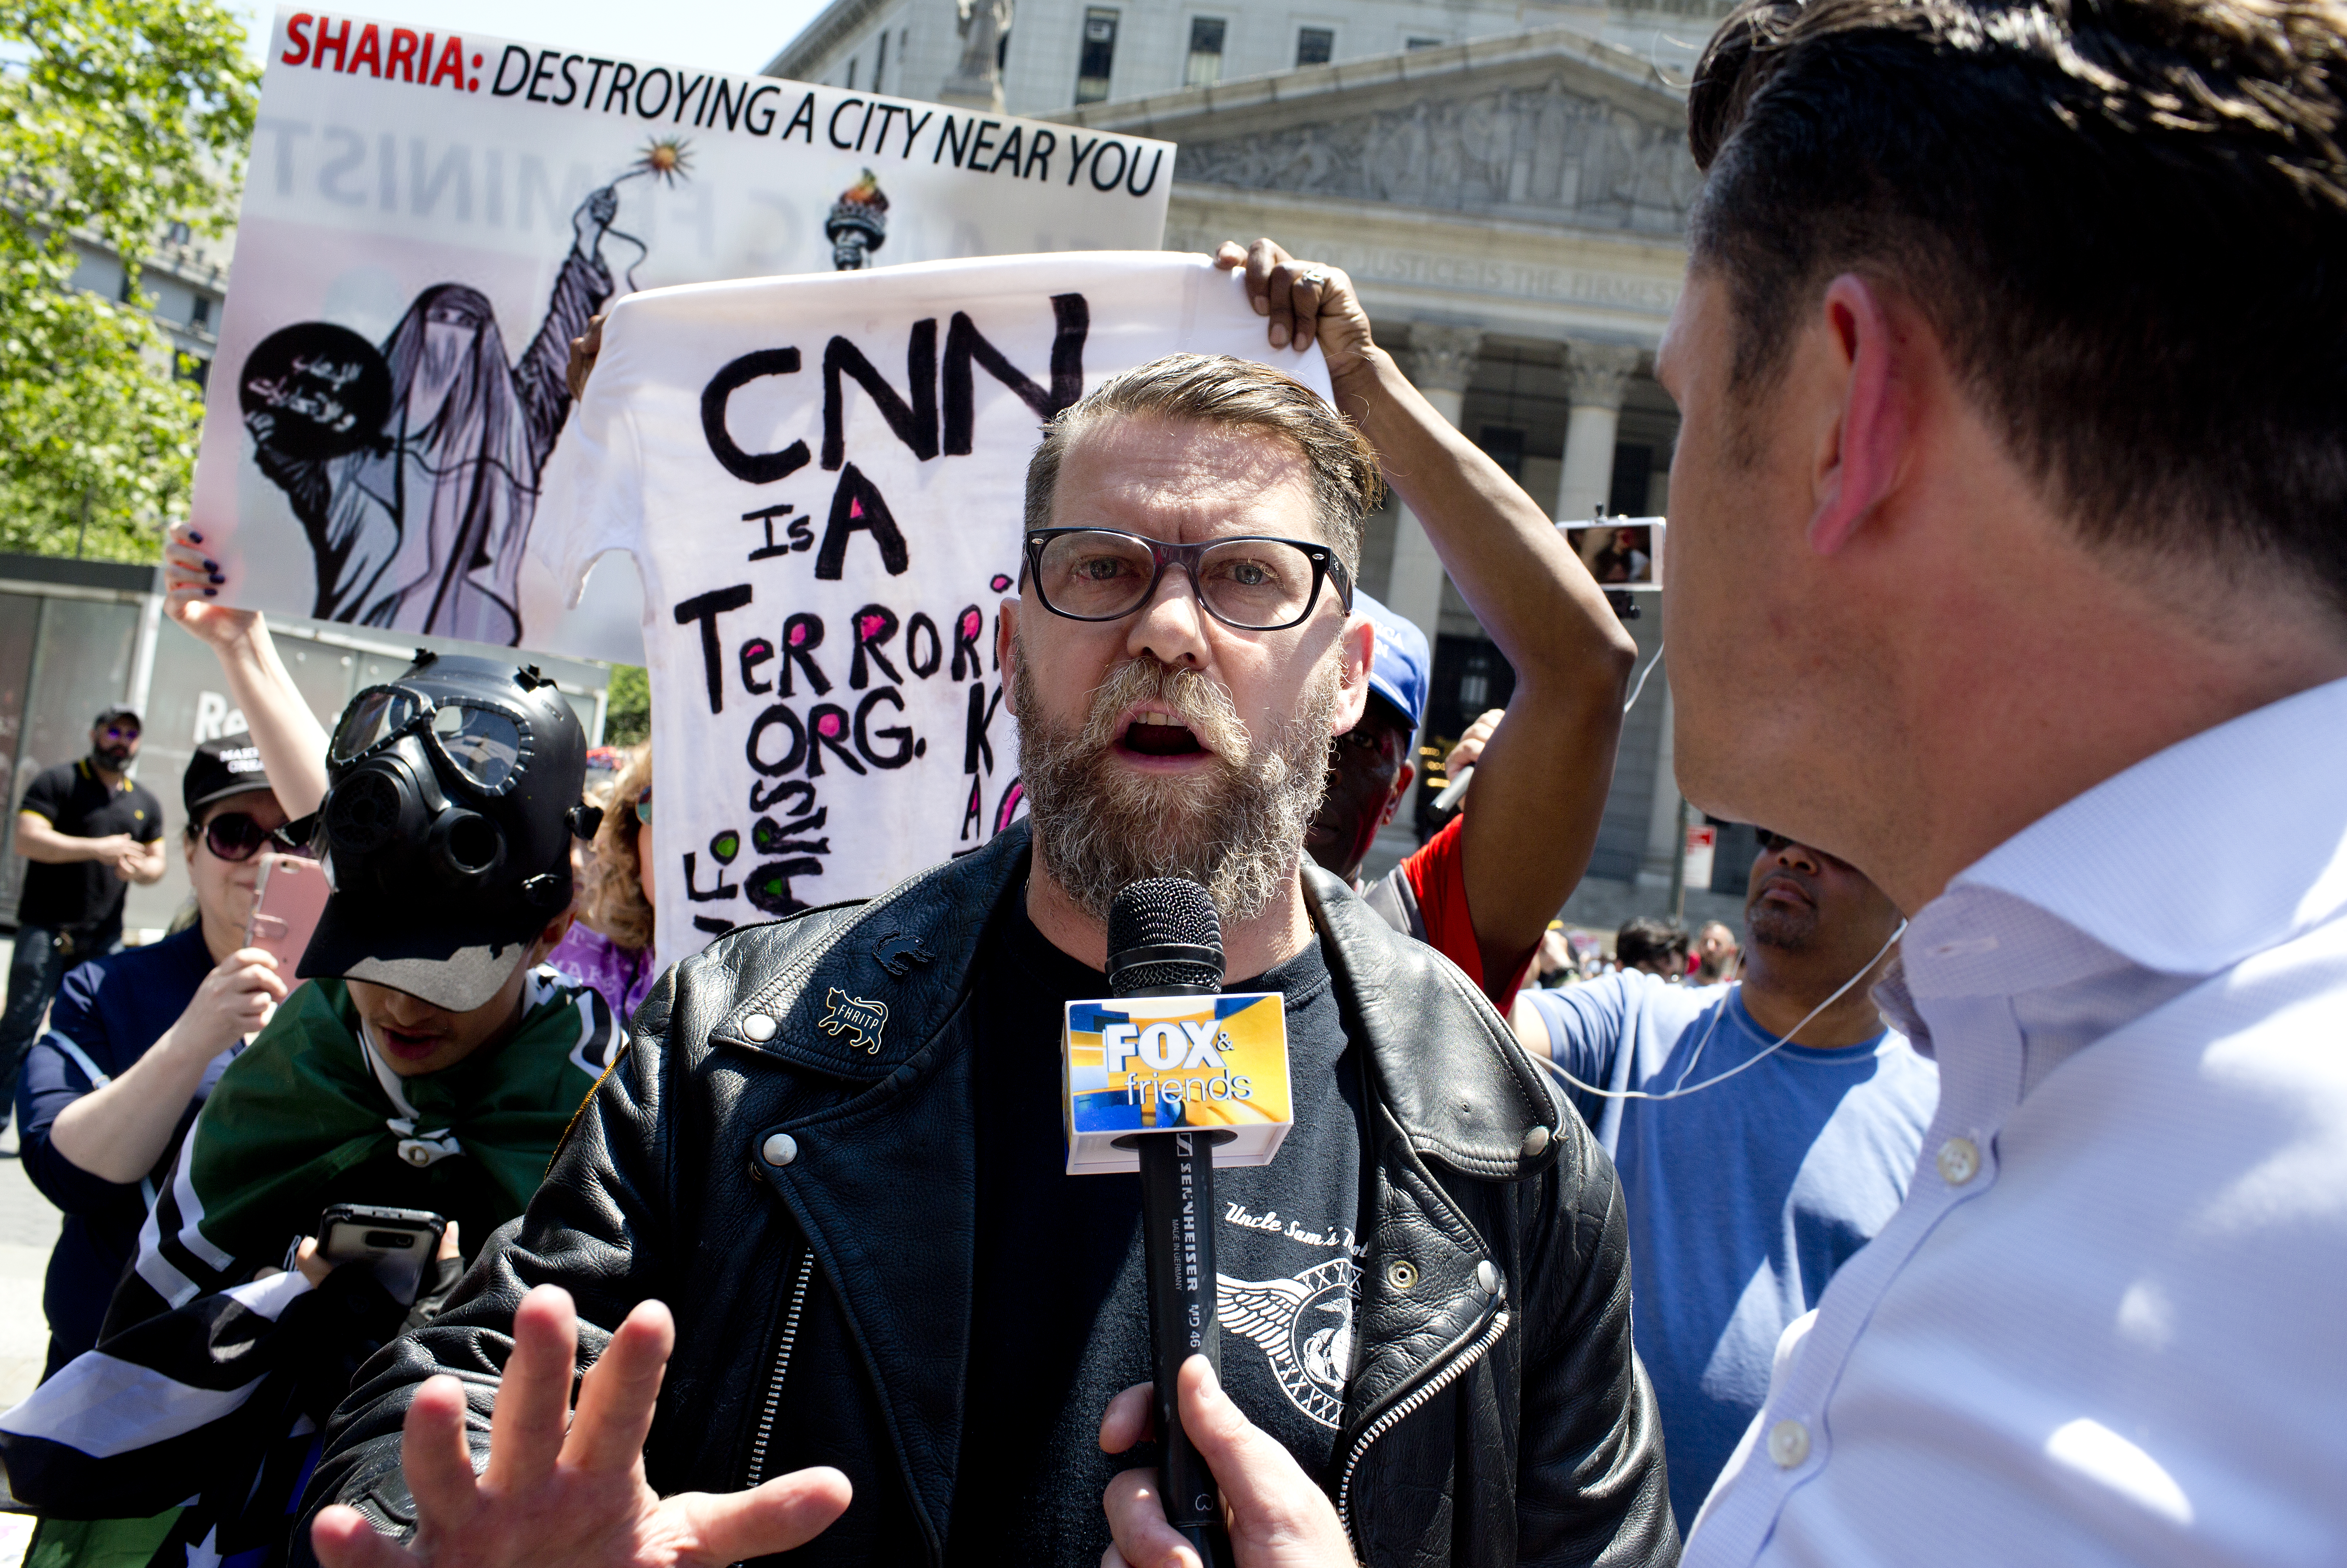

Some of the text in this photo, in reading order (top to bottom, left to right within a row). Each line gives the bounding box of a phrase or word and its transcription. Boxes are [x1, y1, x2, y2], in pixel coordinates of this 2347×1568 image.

[281, 12, 1163, 197] SHARIA: DESTROYING A CITY NEAR YOU
[701, 293, 1090, 484] CNN
[814, 461, 909, 580] A
[746, 685, 926, 777] ORG.
[838, 1004, 879, 1029] FHRITP
[1105, 1019, 1235, 1073] FOX &
[1124, 1068, 1254, 1106] friends
[1172, 1219, 1182, 1291] MADE IN GERMANY
[1180, 1163, 1201, 1348] SENNHEISER MD 46
[1225, 1201, 1282, 1231] Uncle
[1284, 1220, 1340, 1246] Sam's
